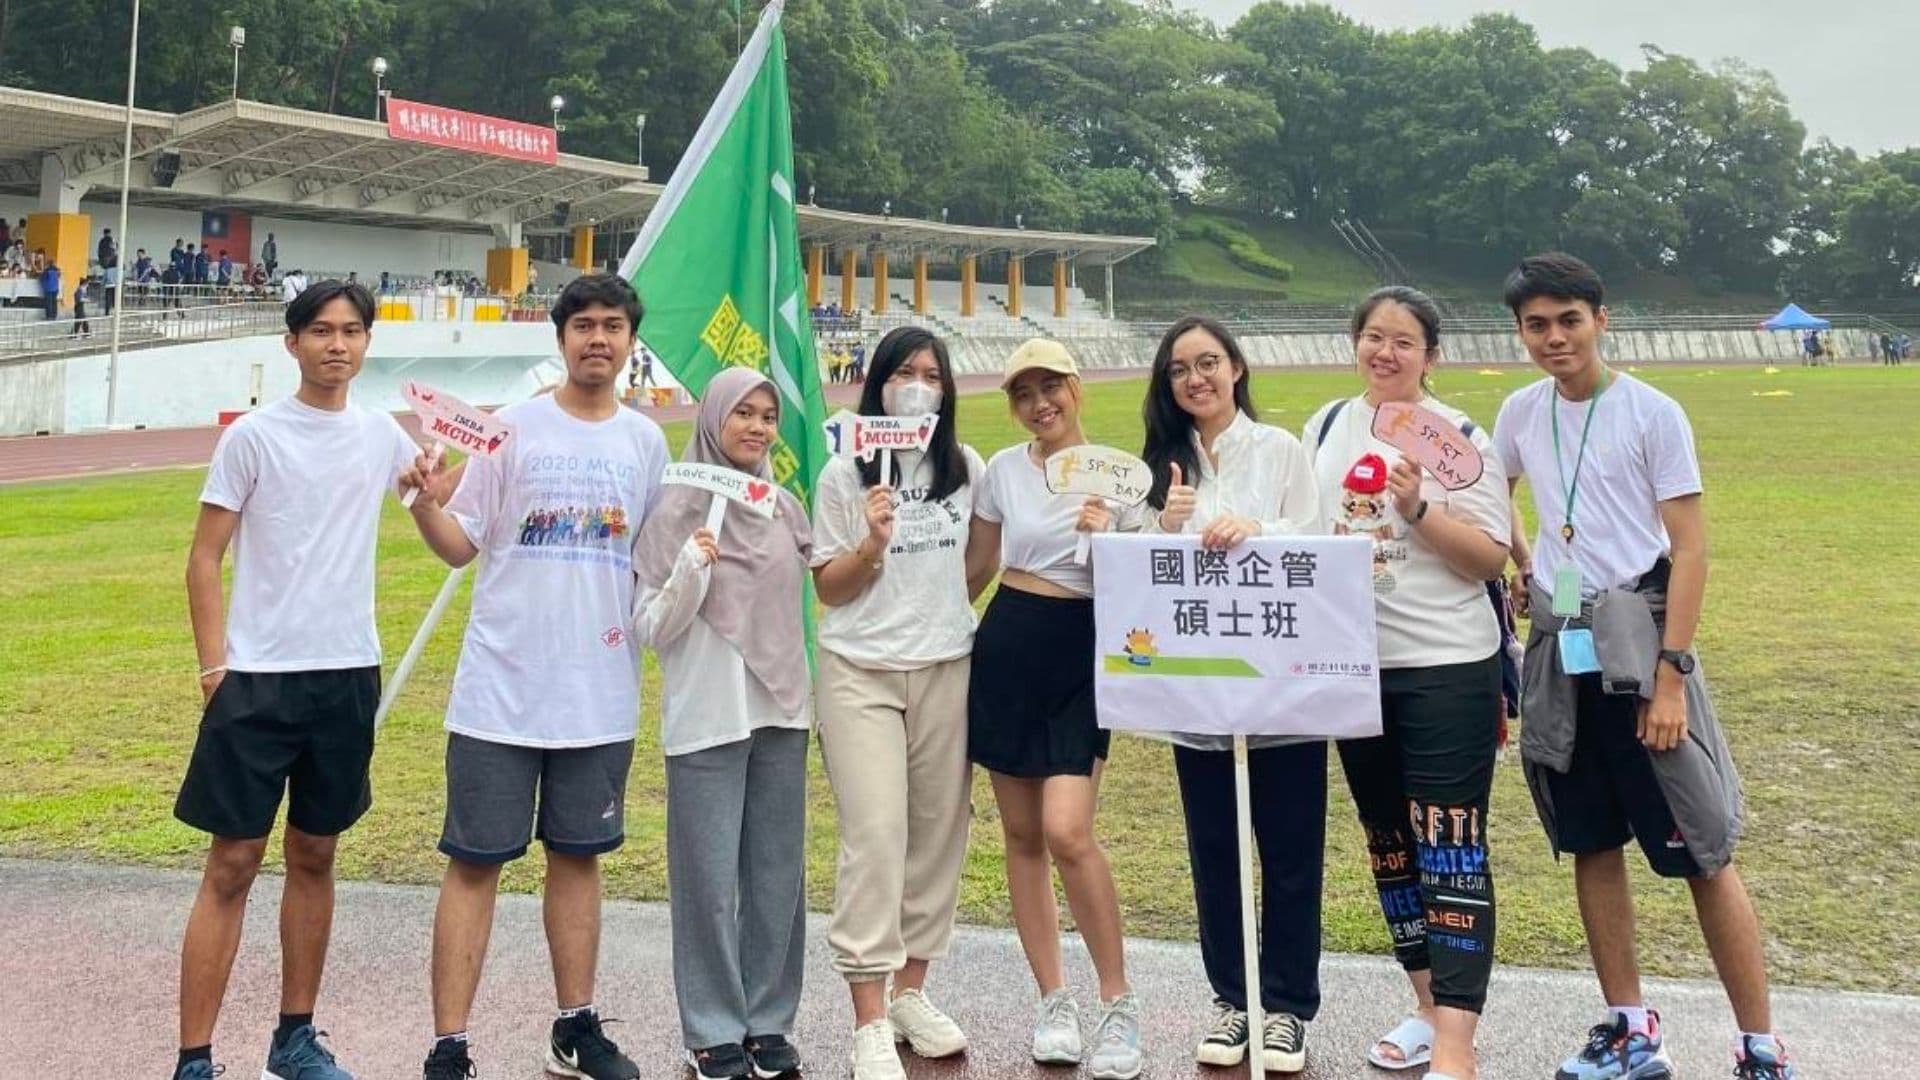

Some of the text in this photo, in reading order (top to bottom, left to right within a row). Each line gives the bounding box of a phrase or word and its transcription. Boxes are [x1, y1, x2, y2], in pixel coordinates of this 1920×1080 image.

[871, 420, 900, 429] IMBA
[431, 417, 486, 451] MCUT
[864, 431, 917, 444] MCUT
[531, 456, 578, 471] 2020
[1436, 460, 1467, 485] DAY
[711, 473, 744, 491] MCUT
[1114, 483, 1146, 499] DAY
[1150, 548, 1318, 589] 國際企管
[1173, 599, 1299, 639] 碩士班
